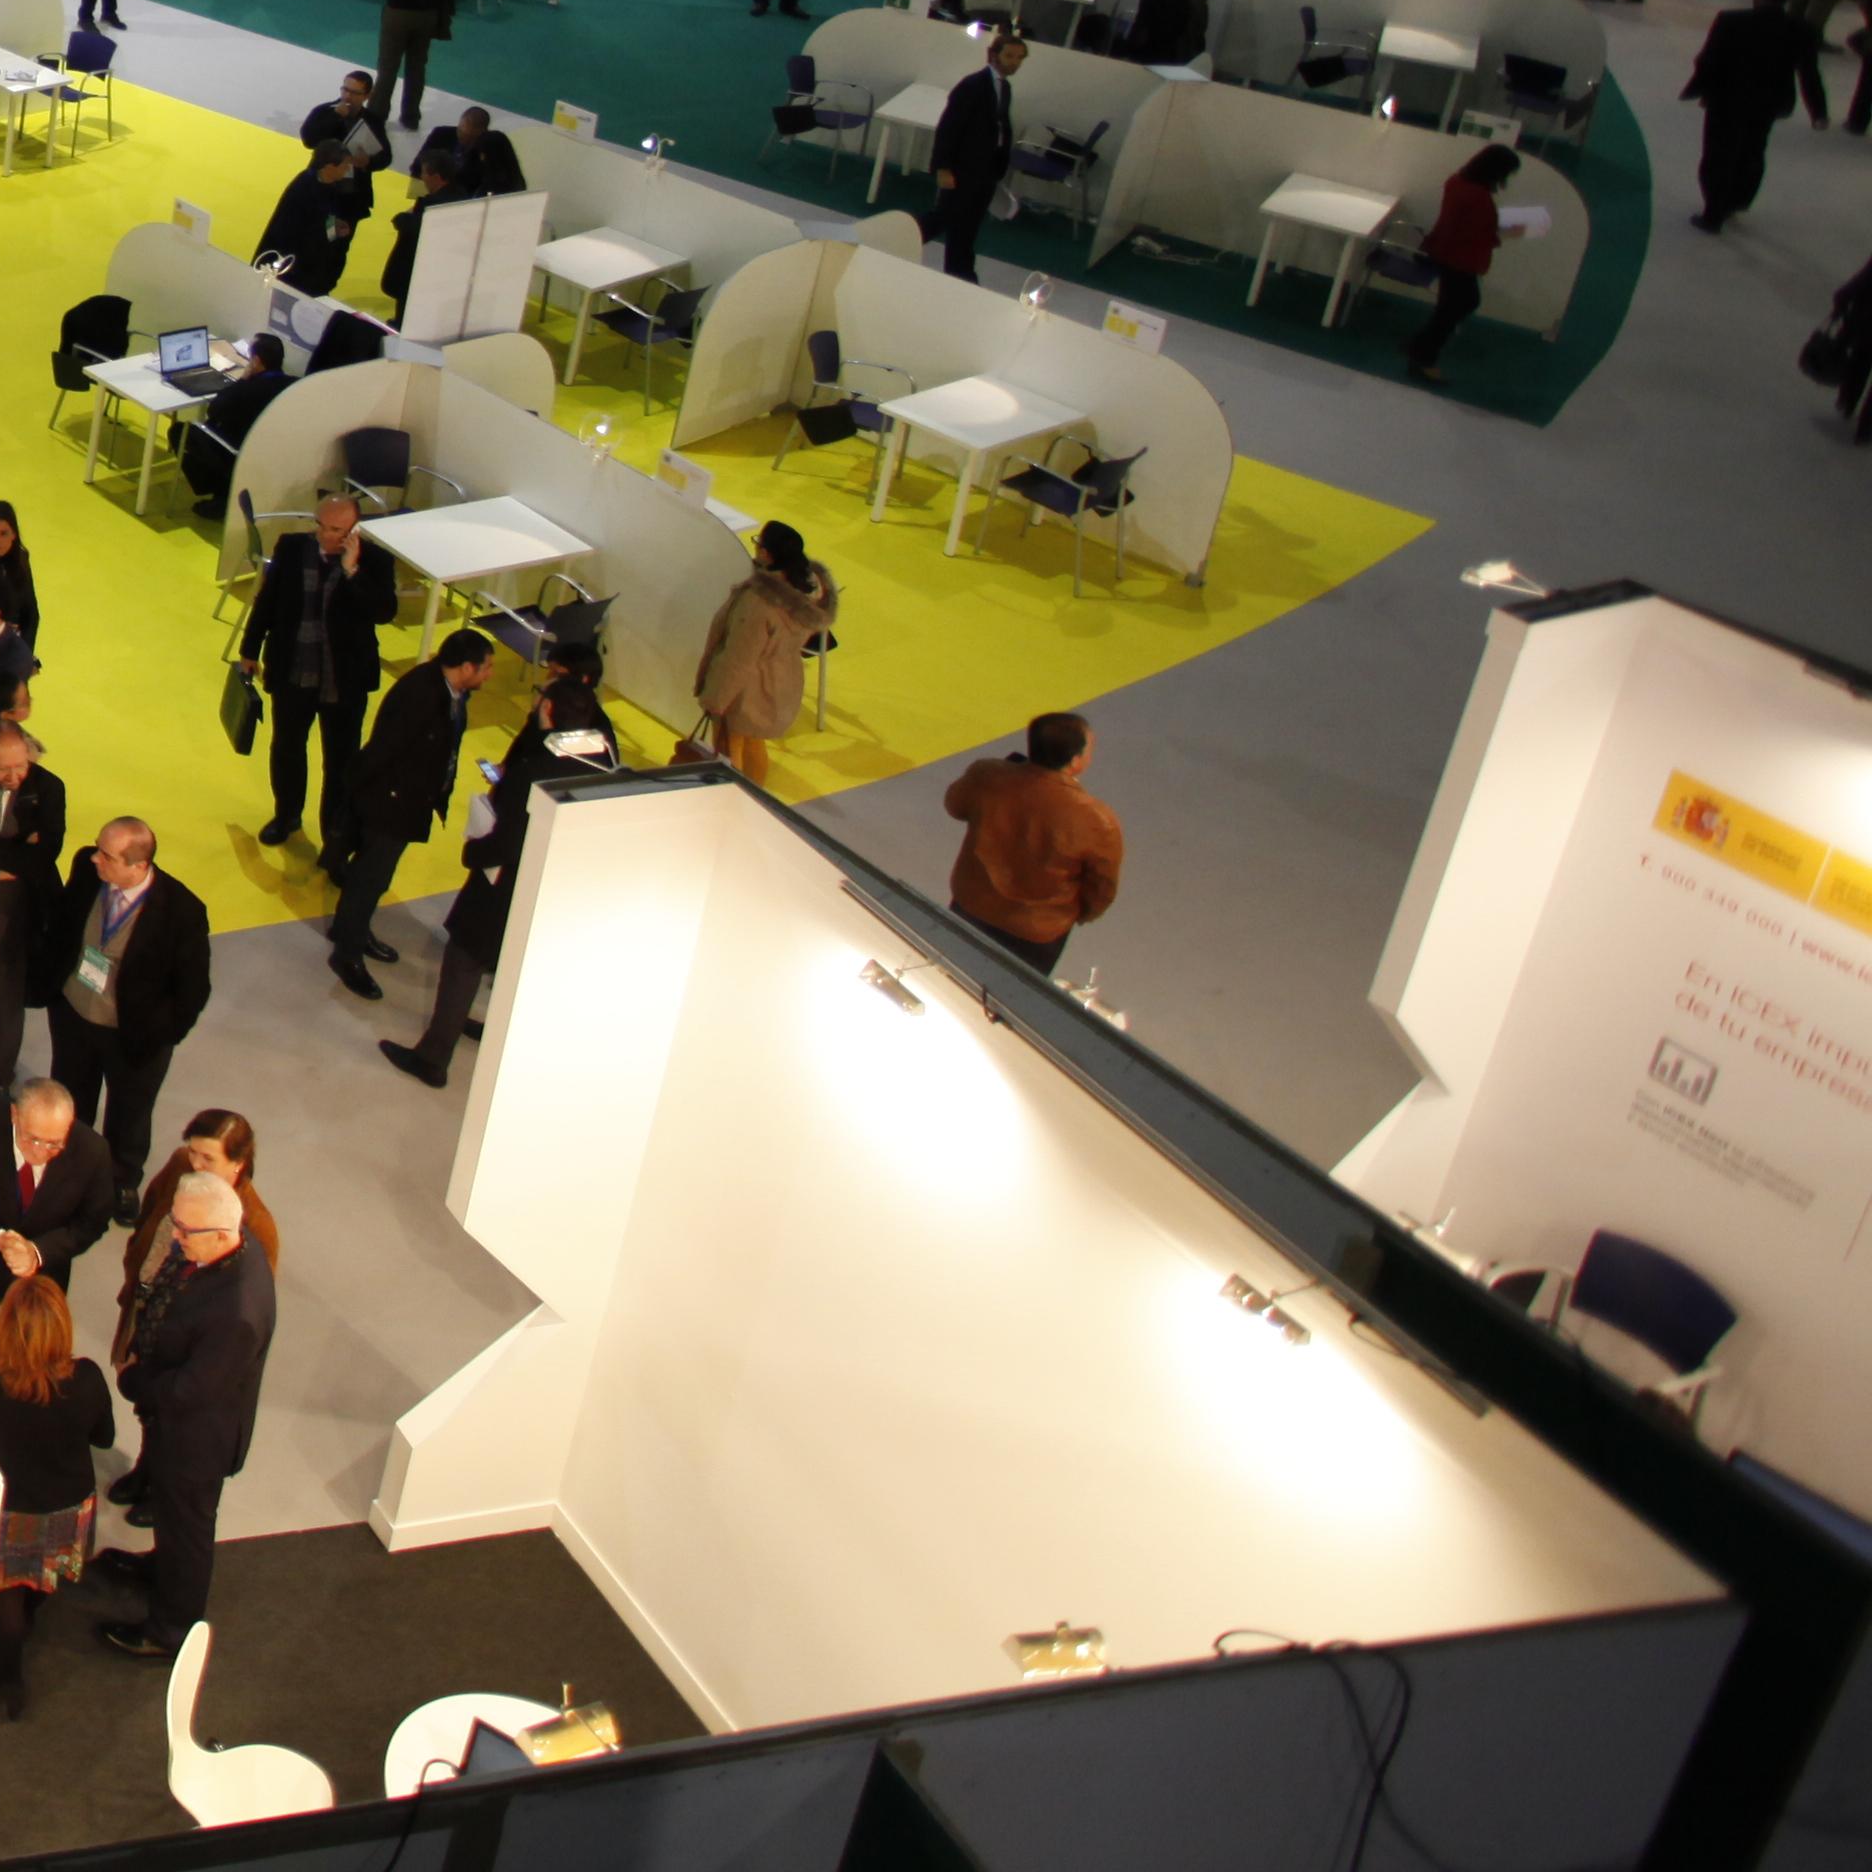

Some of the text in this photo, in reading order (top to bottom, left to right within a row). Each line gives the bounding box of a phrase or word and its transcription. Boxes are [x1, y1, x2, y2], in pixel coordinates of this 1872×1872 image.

[1675, 991, 1711, 1021] de
[1720, 1012, 1747, 1041] tu
[1685, 960, 1721, 996] En
[1730, 985, 1803, 1038] ICEX
